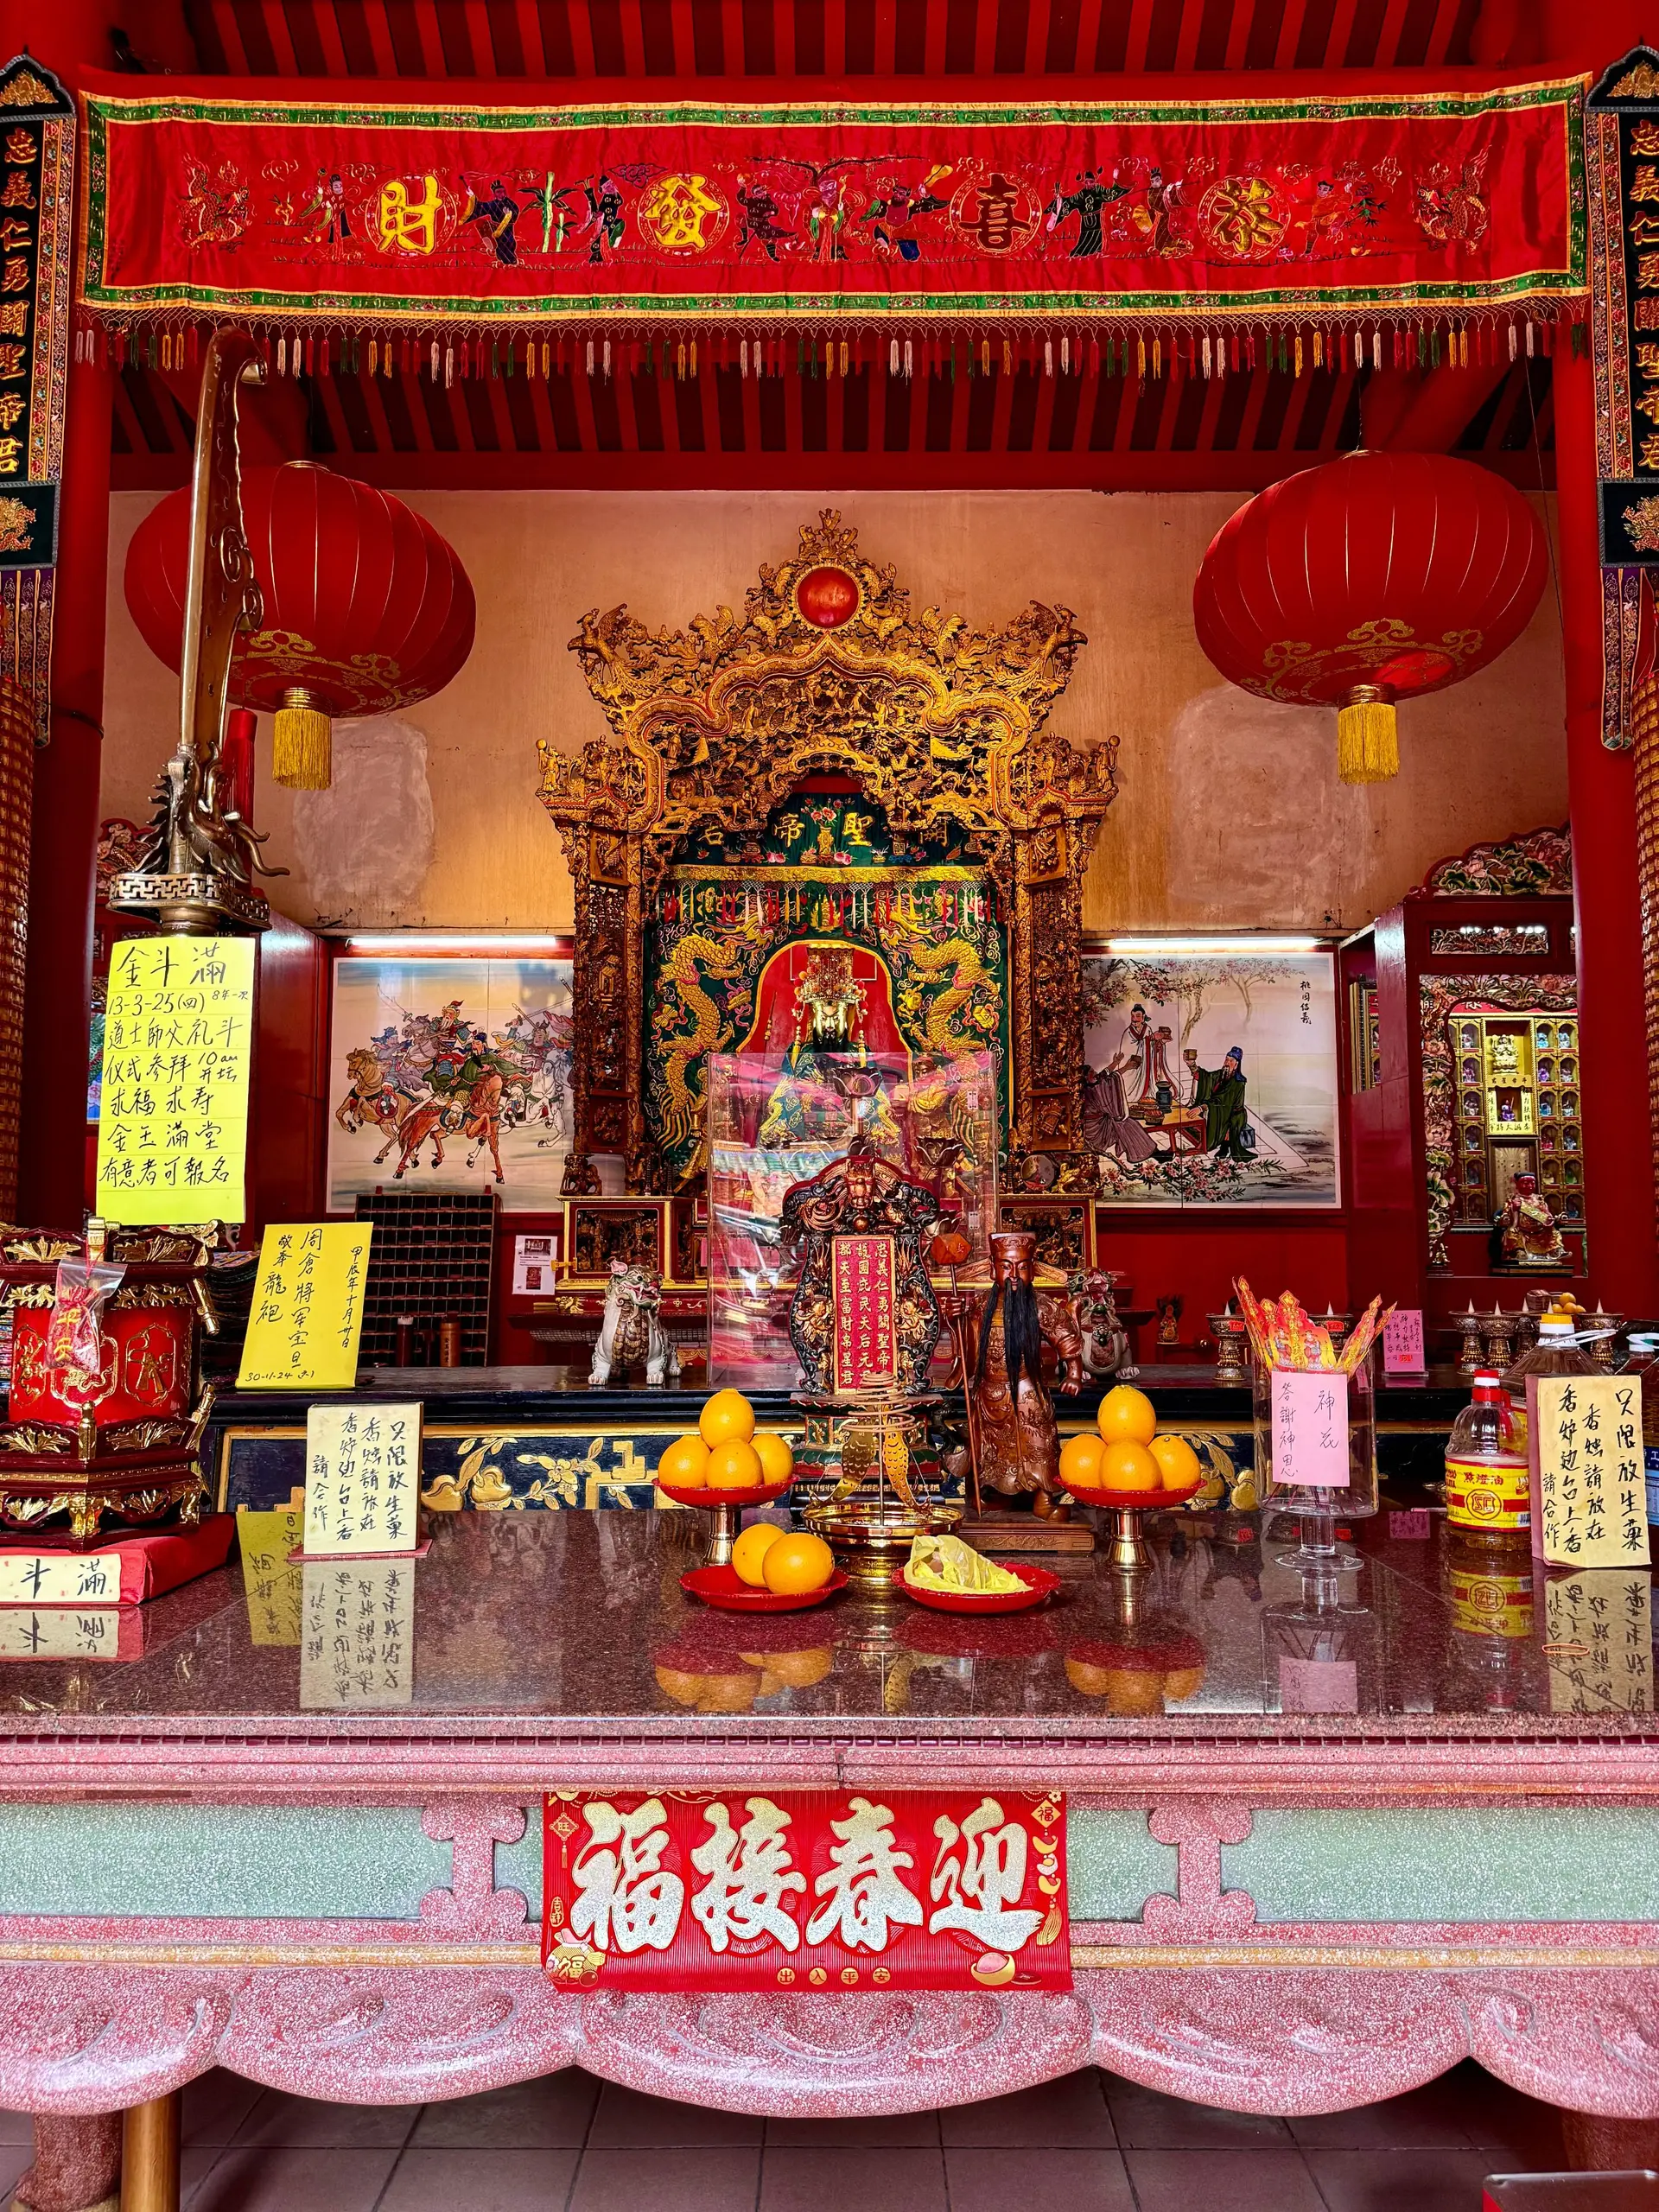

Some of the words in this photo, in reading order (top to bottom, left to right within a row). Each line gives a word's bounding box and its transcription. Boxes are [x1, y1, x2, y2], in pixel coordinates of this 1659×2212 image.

[874, 1242, 891, 1374] 忠義仁勇關聖帝
[779, 1969, 890, 1984] 出入平安
